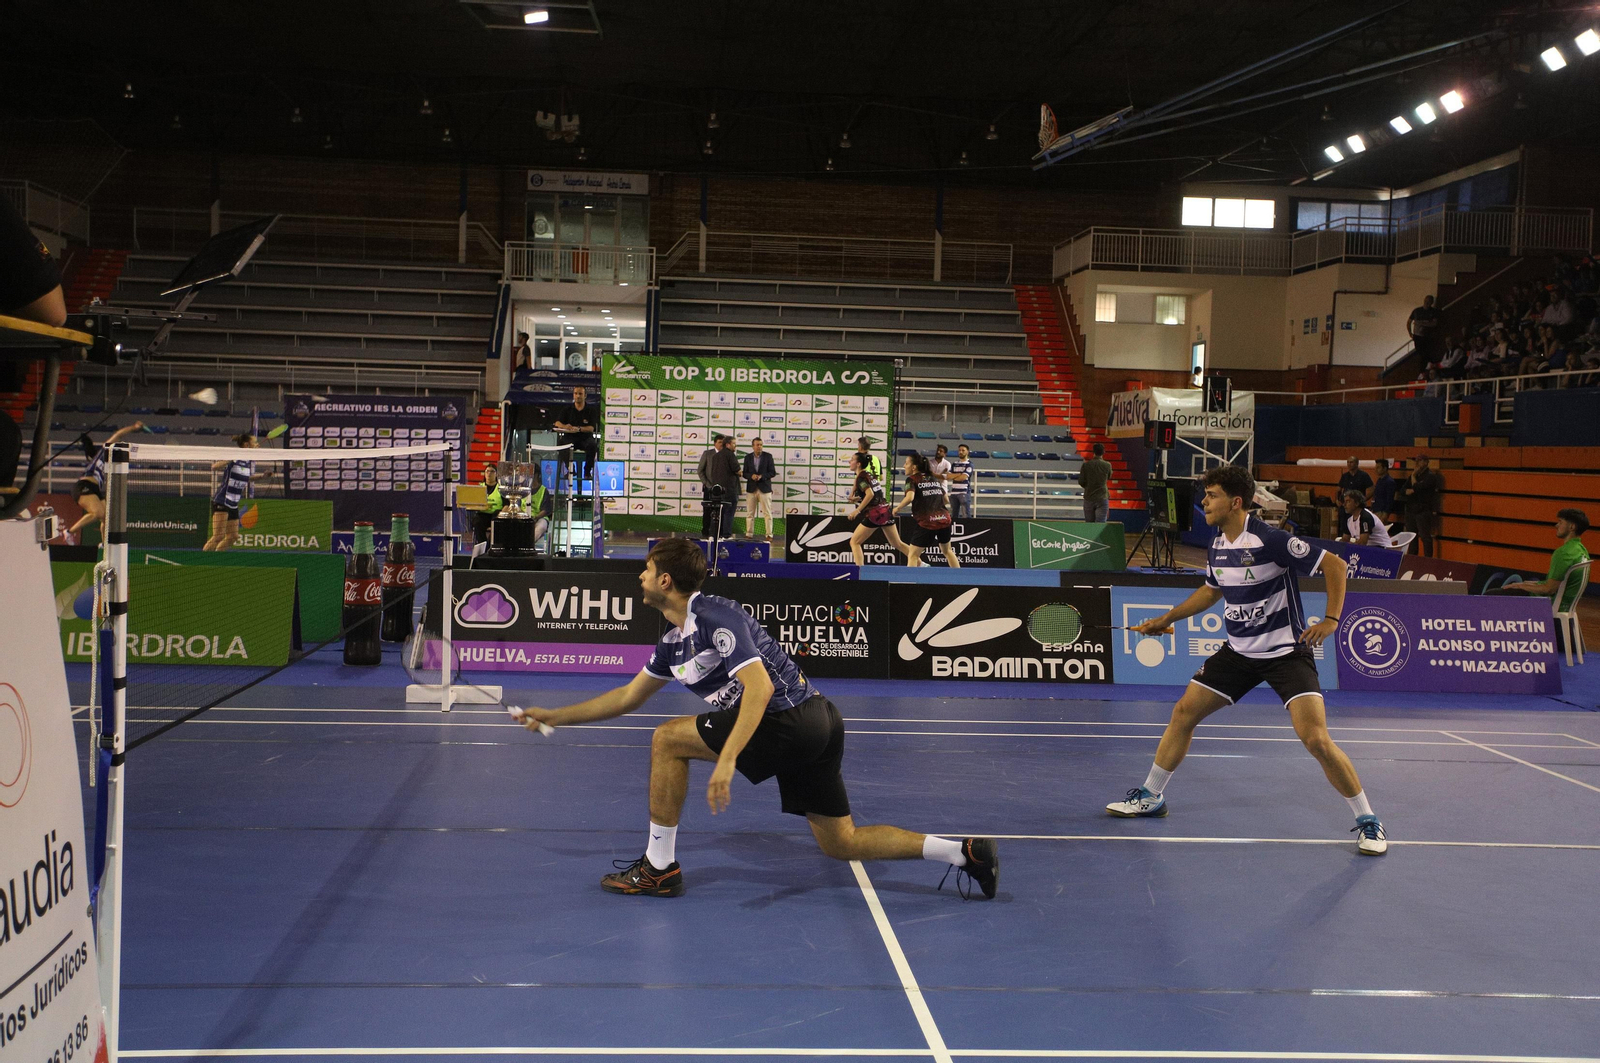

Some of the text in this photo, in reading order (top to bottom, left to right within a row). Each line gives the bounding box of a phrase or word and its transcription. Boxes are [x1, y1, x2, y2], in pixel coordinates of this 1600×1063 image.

[661, 365, 836, 385] TOP 10 IBERDROLA
[373, 404, 389, 412] IES
[391, 405, 404, 413] LA
[405, 405, 438, 414] ORDEN
[1107, 393, 1252, 429] Huelva Información
[610, 477, 617, 490] 0
[233, 533, 320, 548] BERDROLA
[1031, 538, 1041, 548] El
[1041, 538, 1061, 549] Corte
[958, 542, 999, 556] Dental
[927, 555, 948, 563] Valver
[965, 556, 989, 564] Bolado
[1384, 568, 1392, 578] de
[528, 585, 633, 621] WiHu
[741, 600, 869, 625] DIPUTACIÓN
[1360, 609, 1386, 617] ALONSO
[537, 622, 577, 630] INTERNET
[584, 622, 629, 631] TELEFONÍA
[1342, 613, 1359, 634] MARTÍN
[1387, 615, 1406, 635] PINZÓN
[1421, 618, 1546, 633] HOTEL MARTÍN
[780, 625, 868, 643] HUELVA
[66, 632, 249, 660] IBRDROLA
[1417, 638, 1554, 653] ALONSO PINZÓN
[459, 647, 624, 666] HUELVA, ESTA ES TU FIBRA
[820, 649, 869, 658] SOSTENIBLE
[931, 655, 1106, 680] BADMINTON
[1349, 657, 1366, 672] HOTEL
[1367, 658, 1405, 676] APARTAMENTO
[1462, 659, 1547, 674] MAZAGÓN
[29, 940, 88, 1020] Jurídicos
[75, 1014, 89, 1051] 86
